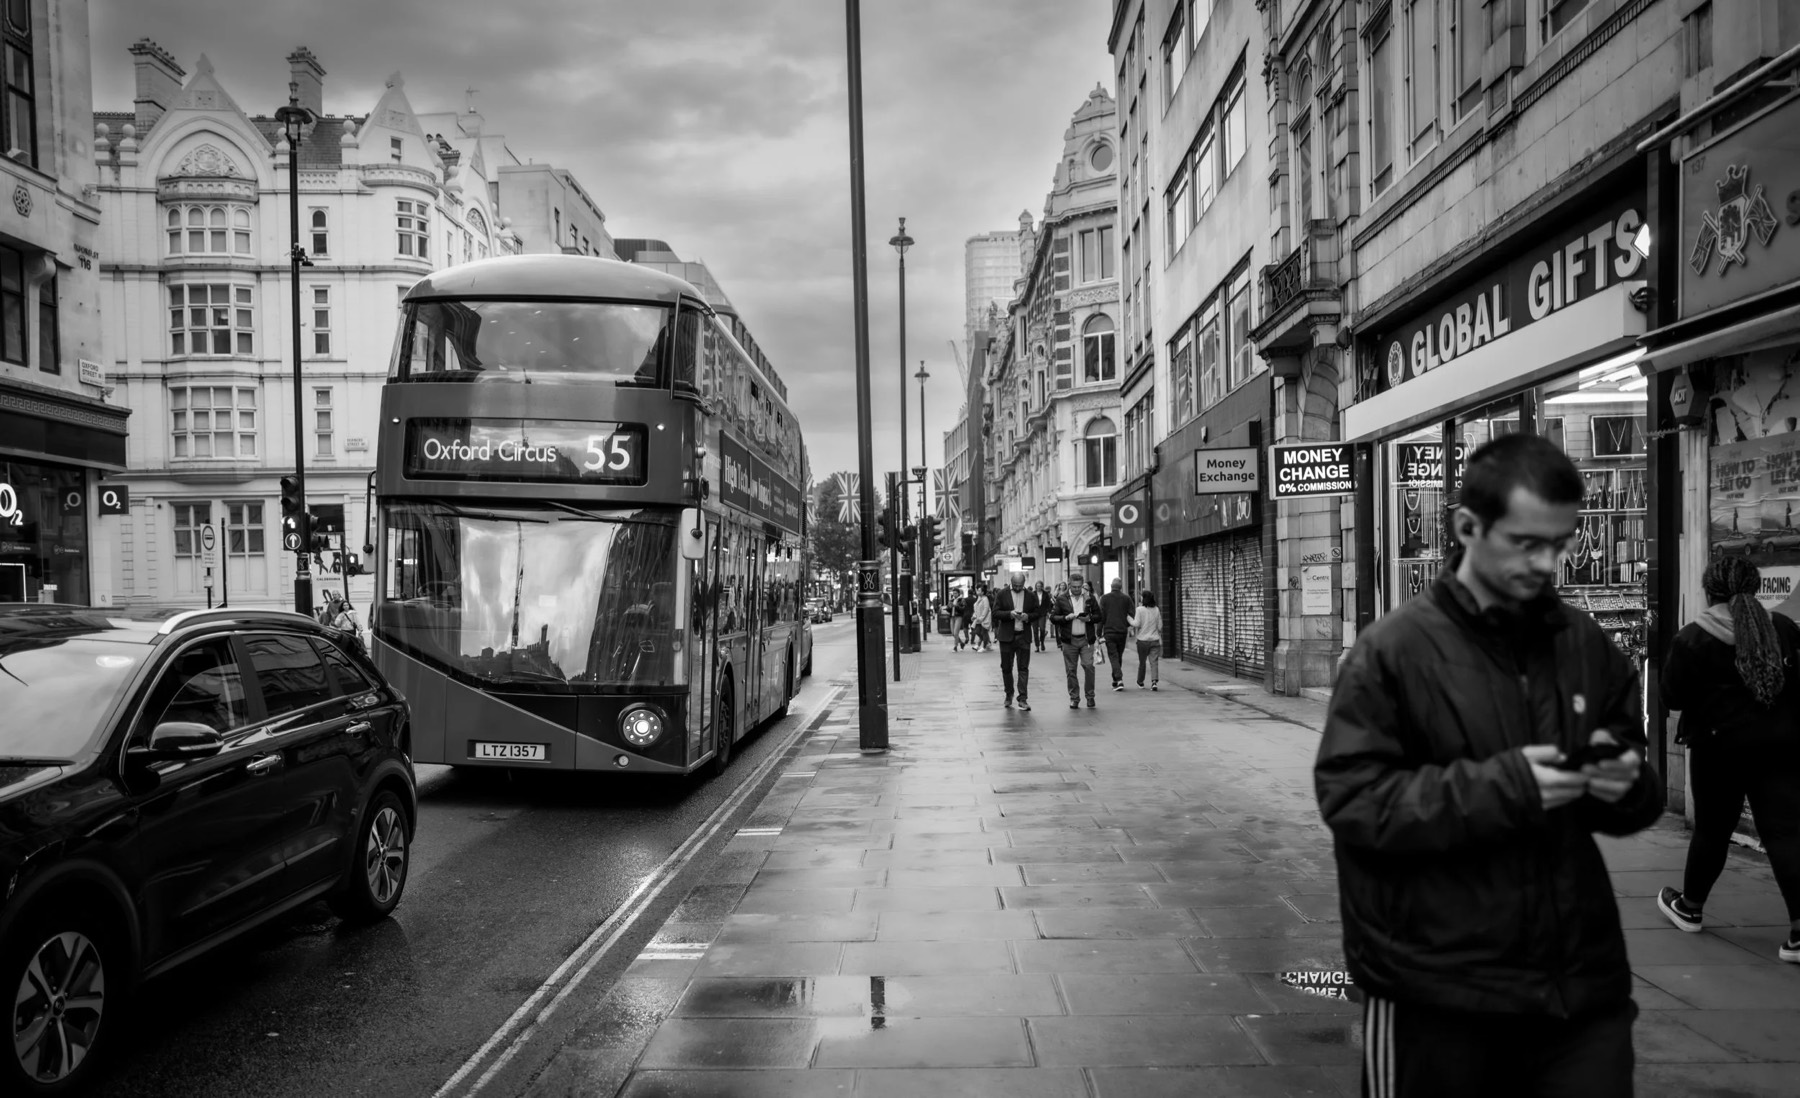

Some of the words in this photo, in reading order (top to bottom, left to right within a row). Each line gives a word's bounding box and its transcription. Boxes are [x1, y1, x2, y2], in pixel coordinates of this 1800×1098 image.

[1411, 284, 1511, 377] GLOBAL
[1528, 208, 1643, 320] GIFTS
[424, 438, 490, 461] Oxford
[498, 440, 557, 462] Circus
[584, 435, 631, 470] 55
[1283, 448, 1343, 464] MONEY
[1766, 451, 1793, 471] HOW
[1206, 459, 1246, 469] Money
[1279, 464, 1350, 481] CHANGE
[1716, 461, 1740, 478] HOW
[1741, 460, 1755, 474] TO
[1200, 471, 1255, 482] Exchange
[1720, 479, 1734, 492] LET
[1736, 476, 1751, 490] GO
[1278, 483, 1297, 493] 0%
[1297, 480, 1352, 492] COMMISSION
[103, 490, 121, 509] O2
[1762, 576, 1791, 593] FACING
[482, 744, 507, 757] LTZ
[510, 745, 538, 757] 1357
